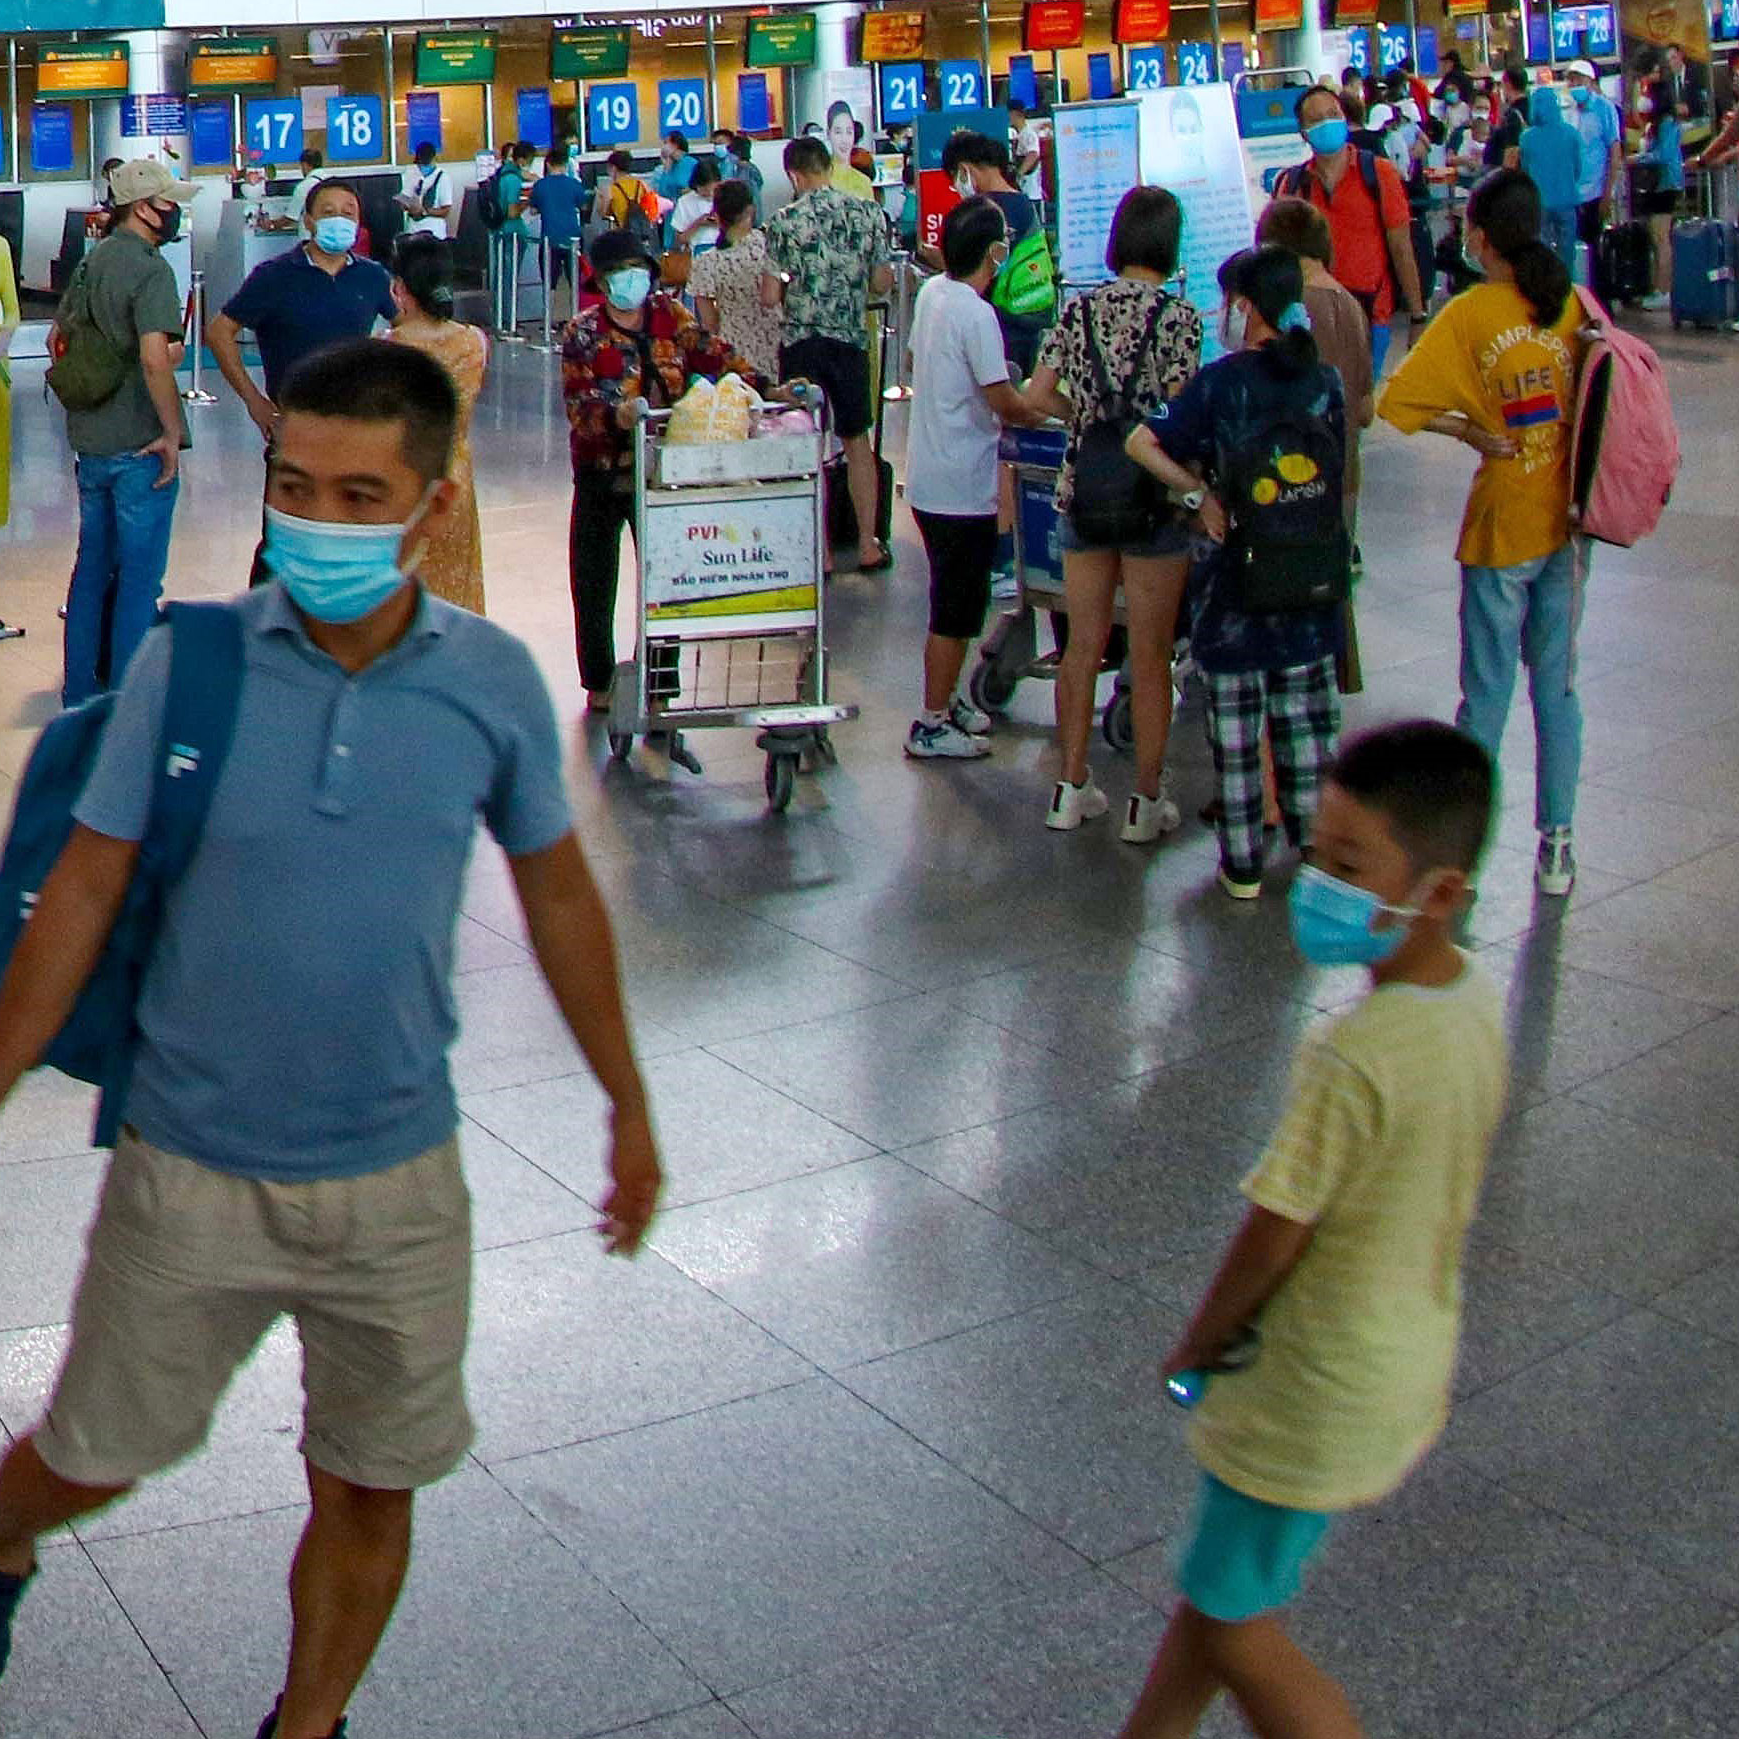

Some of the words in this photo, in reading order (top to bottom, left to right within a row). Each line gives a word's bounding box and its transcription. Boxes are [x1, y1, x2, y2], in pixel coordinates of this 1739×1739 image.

[1556, 23, 1574, 50] 27
[1588, 18, 1610, 45] 28
[1382, 36, 1407, 67] 26
[1133, 59, 1161, 90] 23
[1183, 52, 1210, 85] 24
[890, 76, 920, 111] 21
[947, 71, 977, 107] 22
[595, 96, 631, 131] 19
[664, 93, 702, 127] 20
[254, 113, 295, 149] 17
[333, 111, 373, 147] 18
[1498, 366, 1553, 401] LIFE
[687, 524, 720, 541] PVI
[703, 548, 736, 566] Sun
[741, 547, 773, 563] Life
